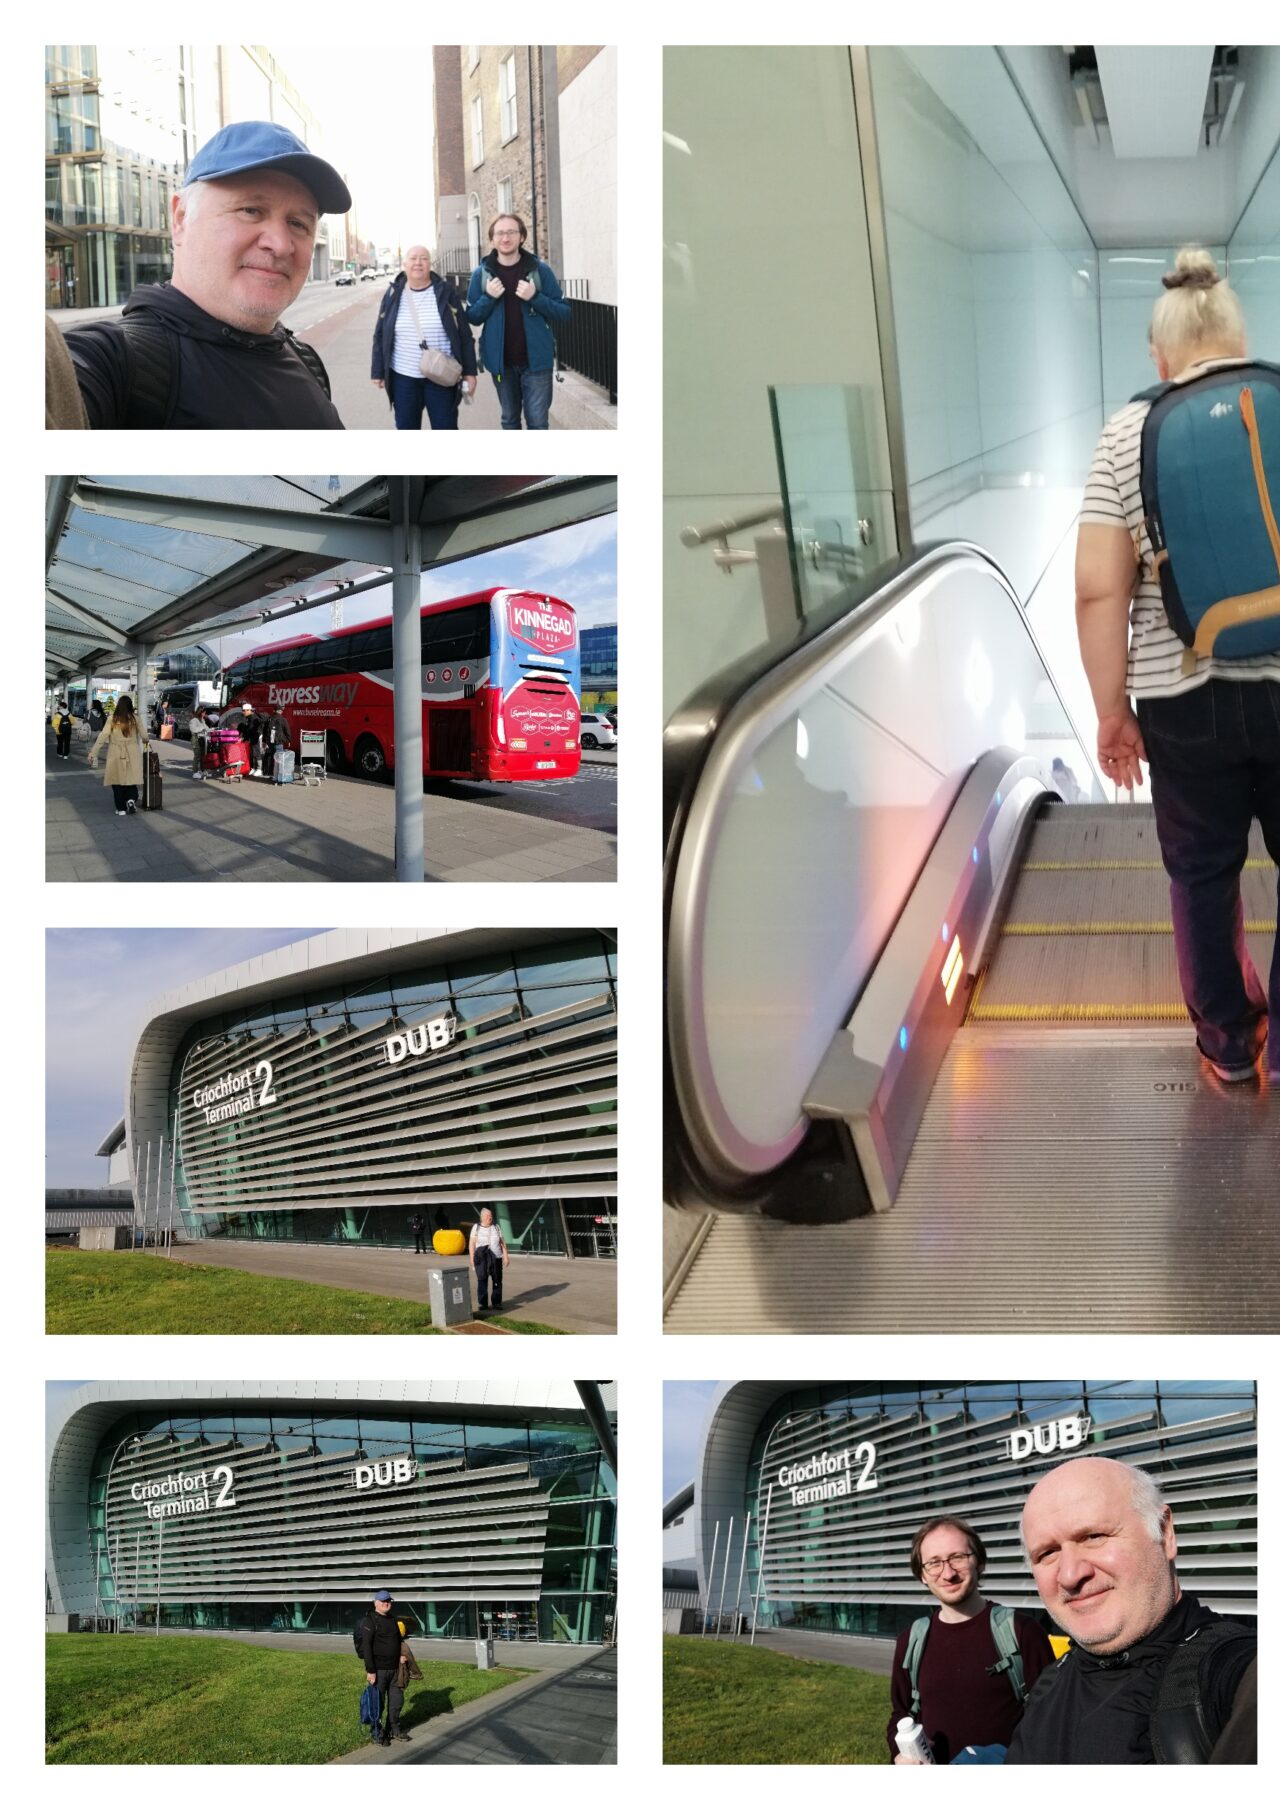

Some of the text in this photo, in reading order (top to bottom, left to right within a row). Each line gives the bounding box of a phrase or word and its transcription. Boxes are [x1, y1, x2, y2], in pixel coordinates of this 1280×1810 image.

[514, 608, 571, 635] KINNEGAD
[536, 631, 559, 643] PLAZA
[268, 682, 359, 709] Expressway
[386, 1018, 450, 1064] DUB
[193, 1069, 253, 1108] Críochfort
[203, 1060, 277, 1125] Terminal 2
[1153, 1083, 1197, 1092] OTIS
[1010, 1416, 1082, 1460] DUB
[131, 1471, 208, 1501] Críochfort
[355, 1459, 412, 1489] DUB
[778, 1448, 851, 1487] Críochfort
[789, 1441, 878, 1506] Terminal 2
[143, 1466, 236, 1519] Terminal 2
